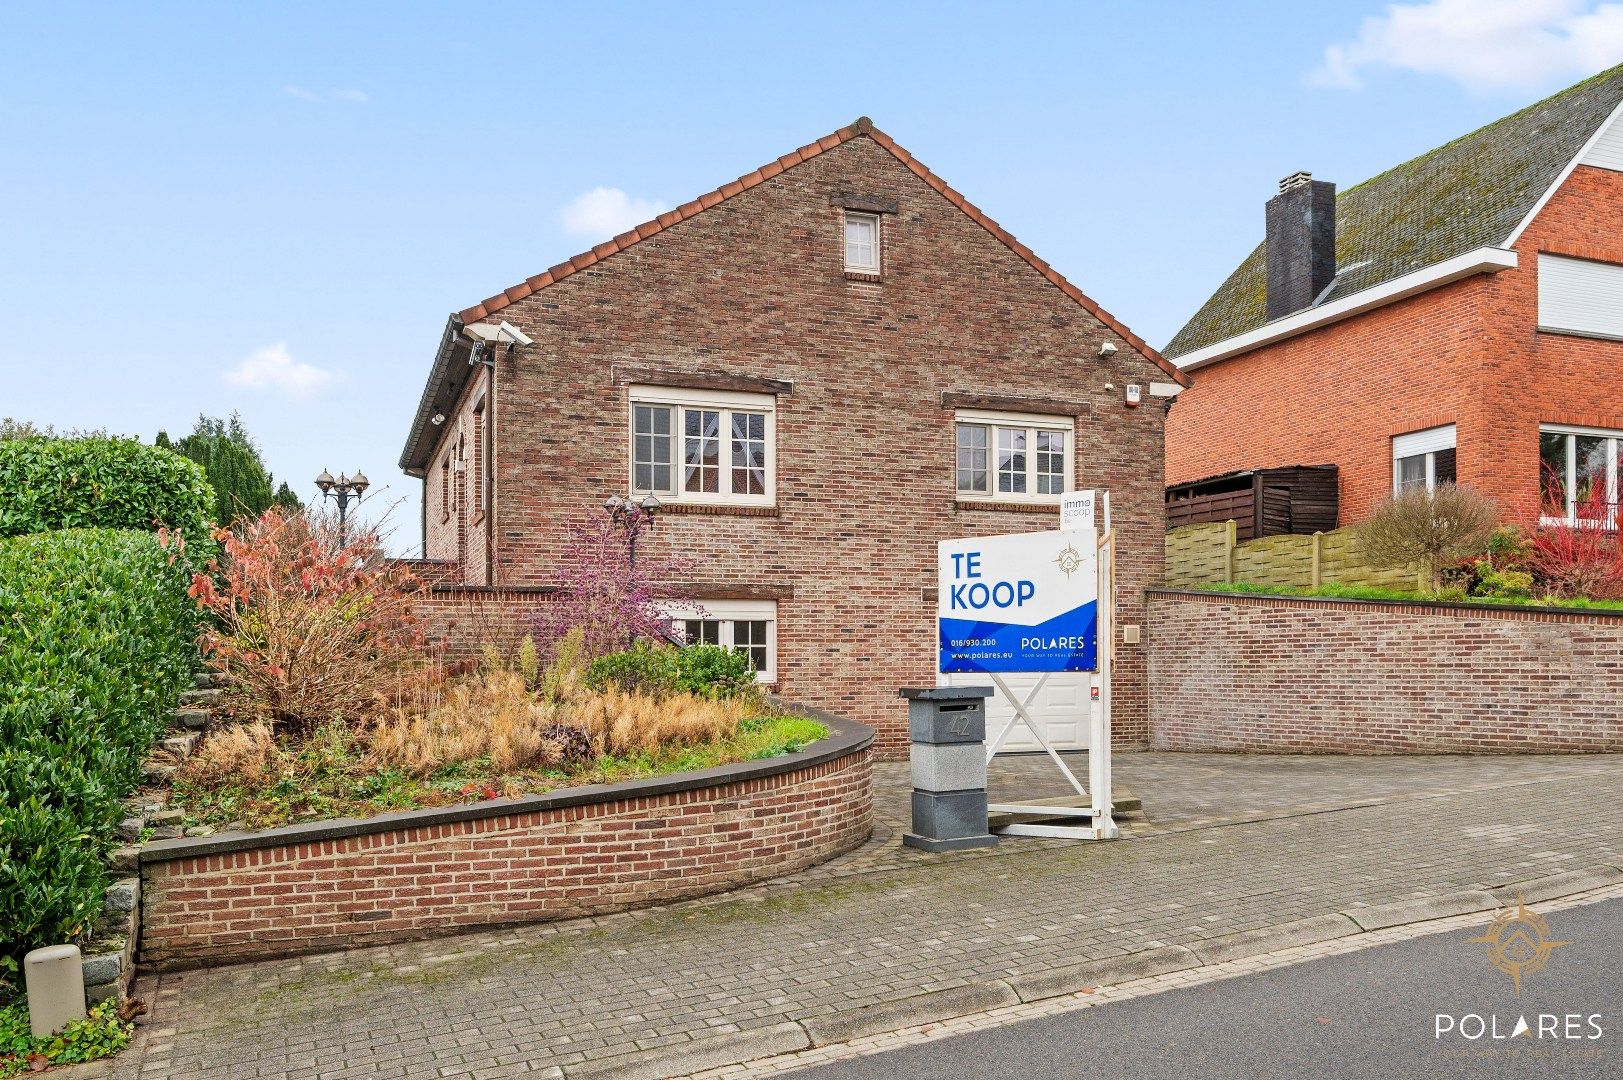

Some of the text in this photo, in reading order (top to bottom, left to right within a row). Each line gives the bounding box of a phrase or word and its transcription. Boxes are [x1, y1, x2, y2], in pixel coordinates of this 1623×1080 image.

[1064, 499, 1091, 509] immo
[1064, 509, 1091, 518] scoop
[950, 552, 981, 579] TE
[950, 580, 1035, 610] KOOP
[950, 639, 996, 647] 016/930.200
[1021, 636, 1084, 650] POLARES
[950, 652, 1013, 661] www.polares.eu
[949, 714, 971, 736] 42
